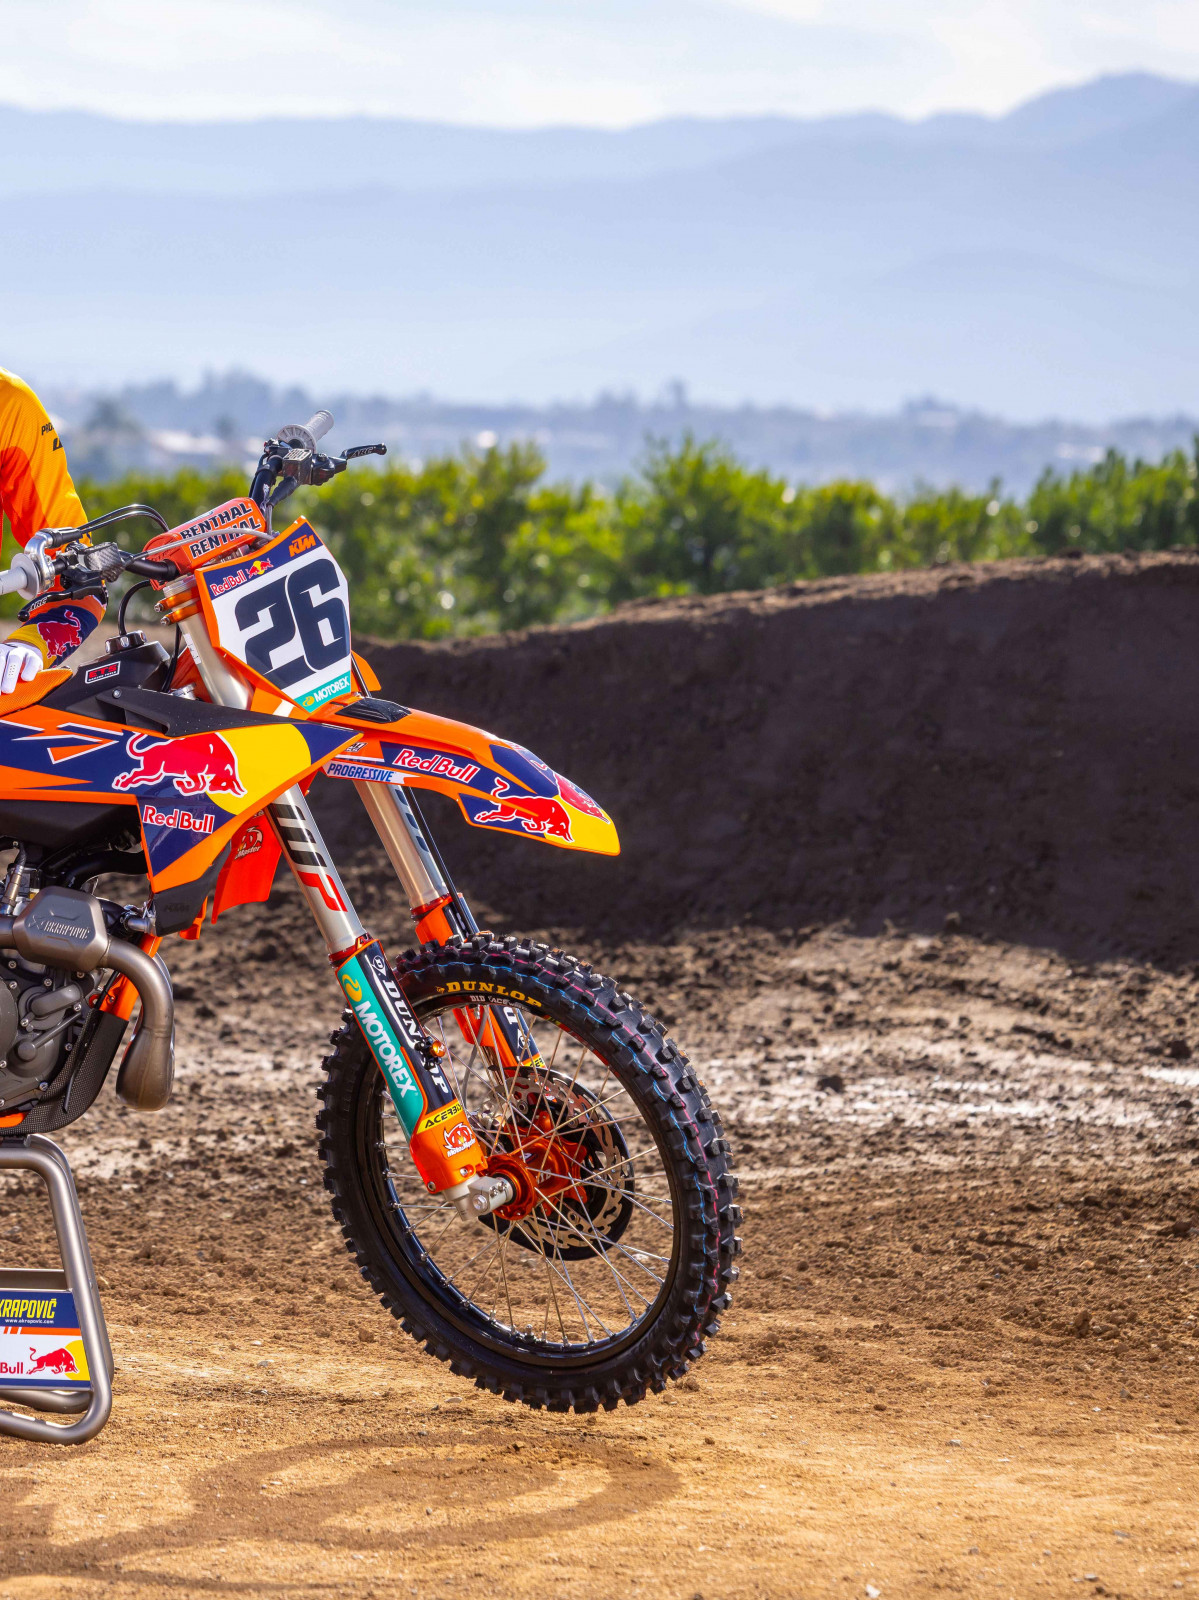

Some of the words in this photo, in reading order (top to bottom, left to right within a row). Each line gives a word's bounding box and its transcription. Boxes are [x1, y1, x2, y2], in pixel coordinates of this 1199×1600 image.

[180, 503, 253, 540] RENTHAL
[189, 516, 261, 558] RENTHAL
[289, 534, 316, 557] KTM
[210, 577, 230, 597] Red
[228, 569, 248, 588] Bull
[234, 557, 352, 691] 26
[314, 676, 350, 702] MOTOREX
[327, 763, 394, 782] PROGRESSIVE
[392, 748, 436, 773] Red
[432, 754, 481, 784] Bull
[143, 805, 178, 829] Red
[178, 810, 216, 835] Bull
[446, 981, 543, 1008] DUNLOP
[355, 1000, 418, 1099] MOTOREX
[0, 1361, 24, 1375] Bull
